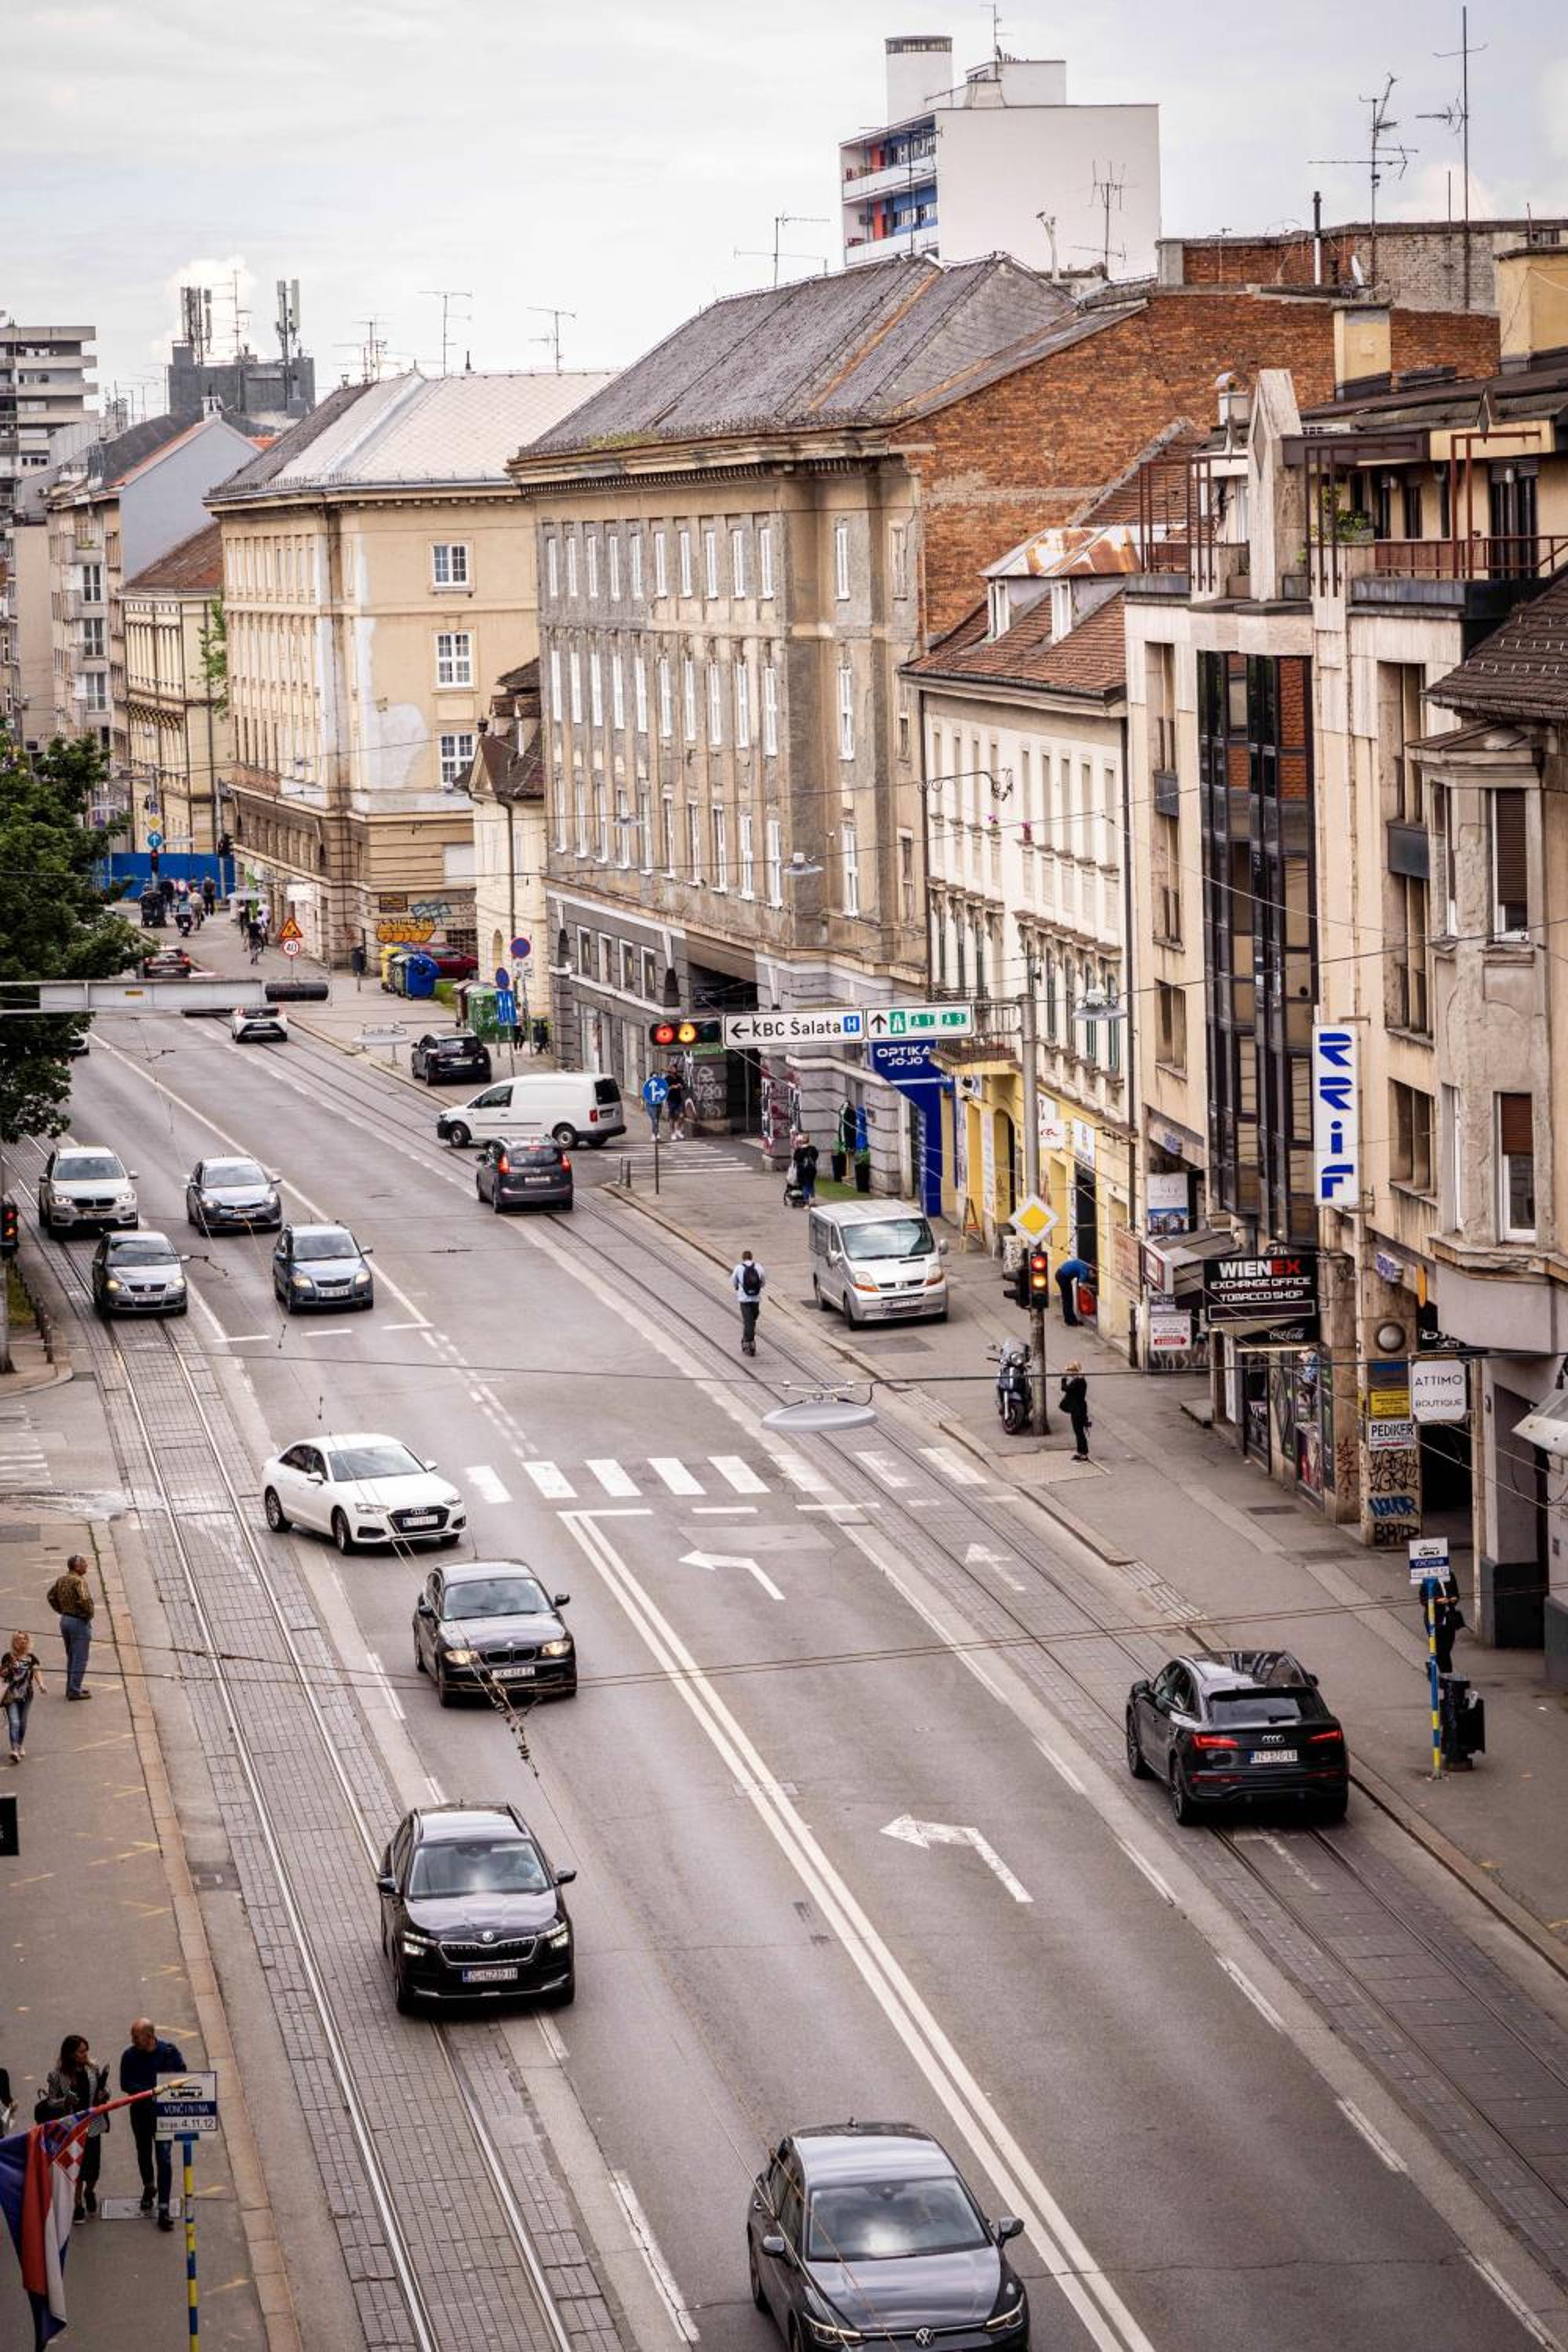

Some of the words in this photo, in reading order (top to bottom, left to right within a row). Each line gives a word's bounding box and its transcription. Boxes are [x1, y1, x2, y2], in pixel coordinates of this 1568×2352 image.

[753, 1021, 785, 1036] KBC
[790, 1017, 841, 1035] Šalata
[877, 1045, 931, 1058] OPTIKA
[1218, 1258, 1301, 1279] WIENEX
[1210, 1279, 1271, 1290] EXCHANGE
[1271, 1276, 1312, 1287] OFFICE
[1220, 1291, 1272, 1301] TOBACCO
[1273, 1290, 1304, 1300] SHOP
[1415, 1374, 1463, 1386] ATTIMO
[1415, 1398, 1464, 1407] BOUTIQUE
